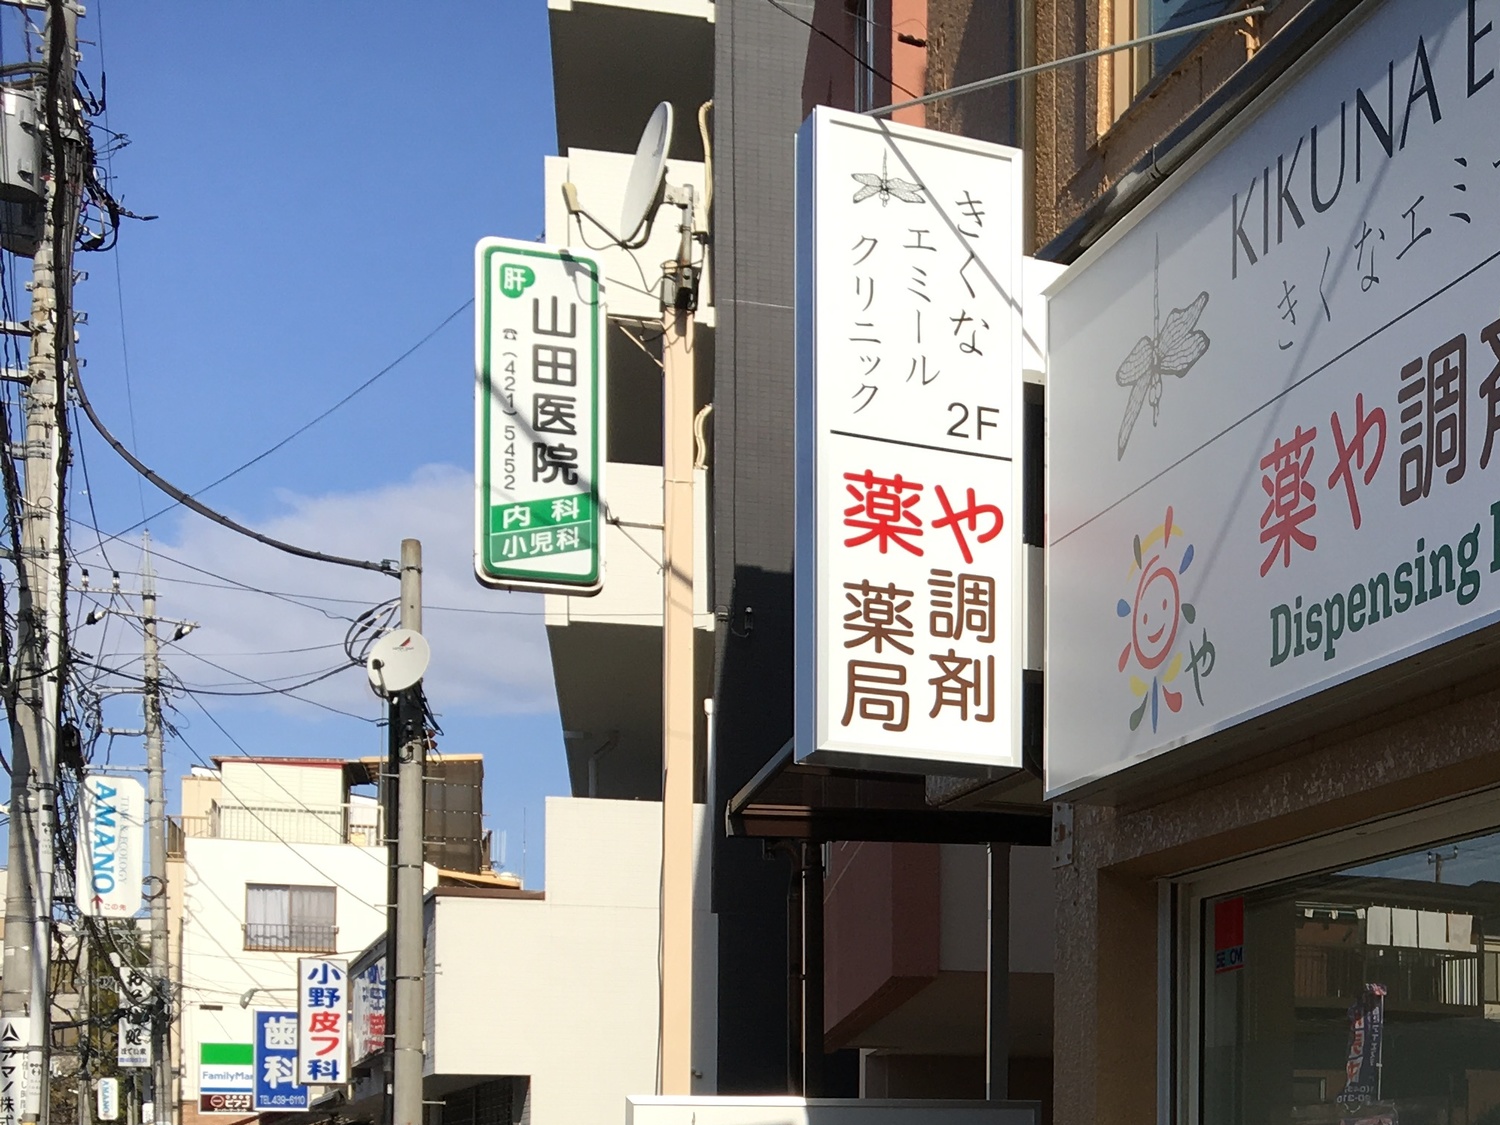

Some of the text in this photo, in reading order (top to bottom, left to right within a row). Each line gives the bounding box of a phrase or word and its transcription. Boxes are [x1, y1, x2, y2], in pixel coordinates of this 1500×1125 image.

[1231, 35, 1442, 281] KIKUNA
[848, 234, 879, 415] クリニック
[902, 226, 940, 387] エミール
[949, 189, 990, 358] きくな
[531, 295, 579, 486] 山田医院
[946, 401, 1000, 442] 2F
[502, 496, 580, 530] 内科
[502, 529, 580, 559] 小児科
[841, 578, 915, 733] 薬局
[926, 567, 996, 725] 調剤
[1270, 522, 1481, 667] Dispensing
[91, 780, 117, 895] AMANO
[263, 1016, 299, 1090] 歯科
[307, 963, 342, 1081] 小野皮フ科
